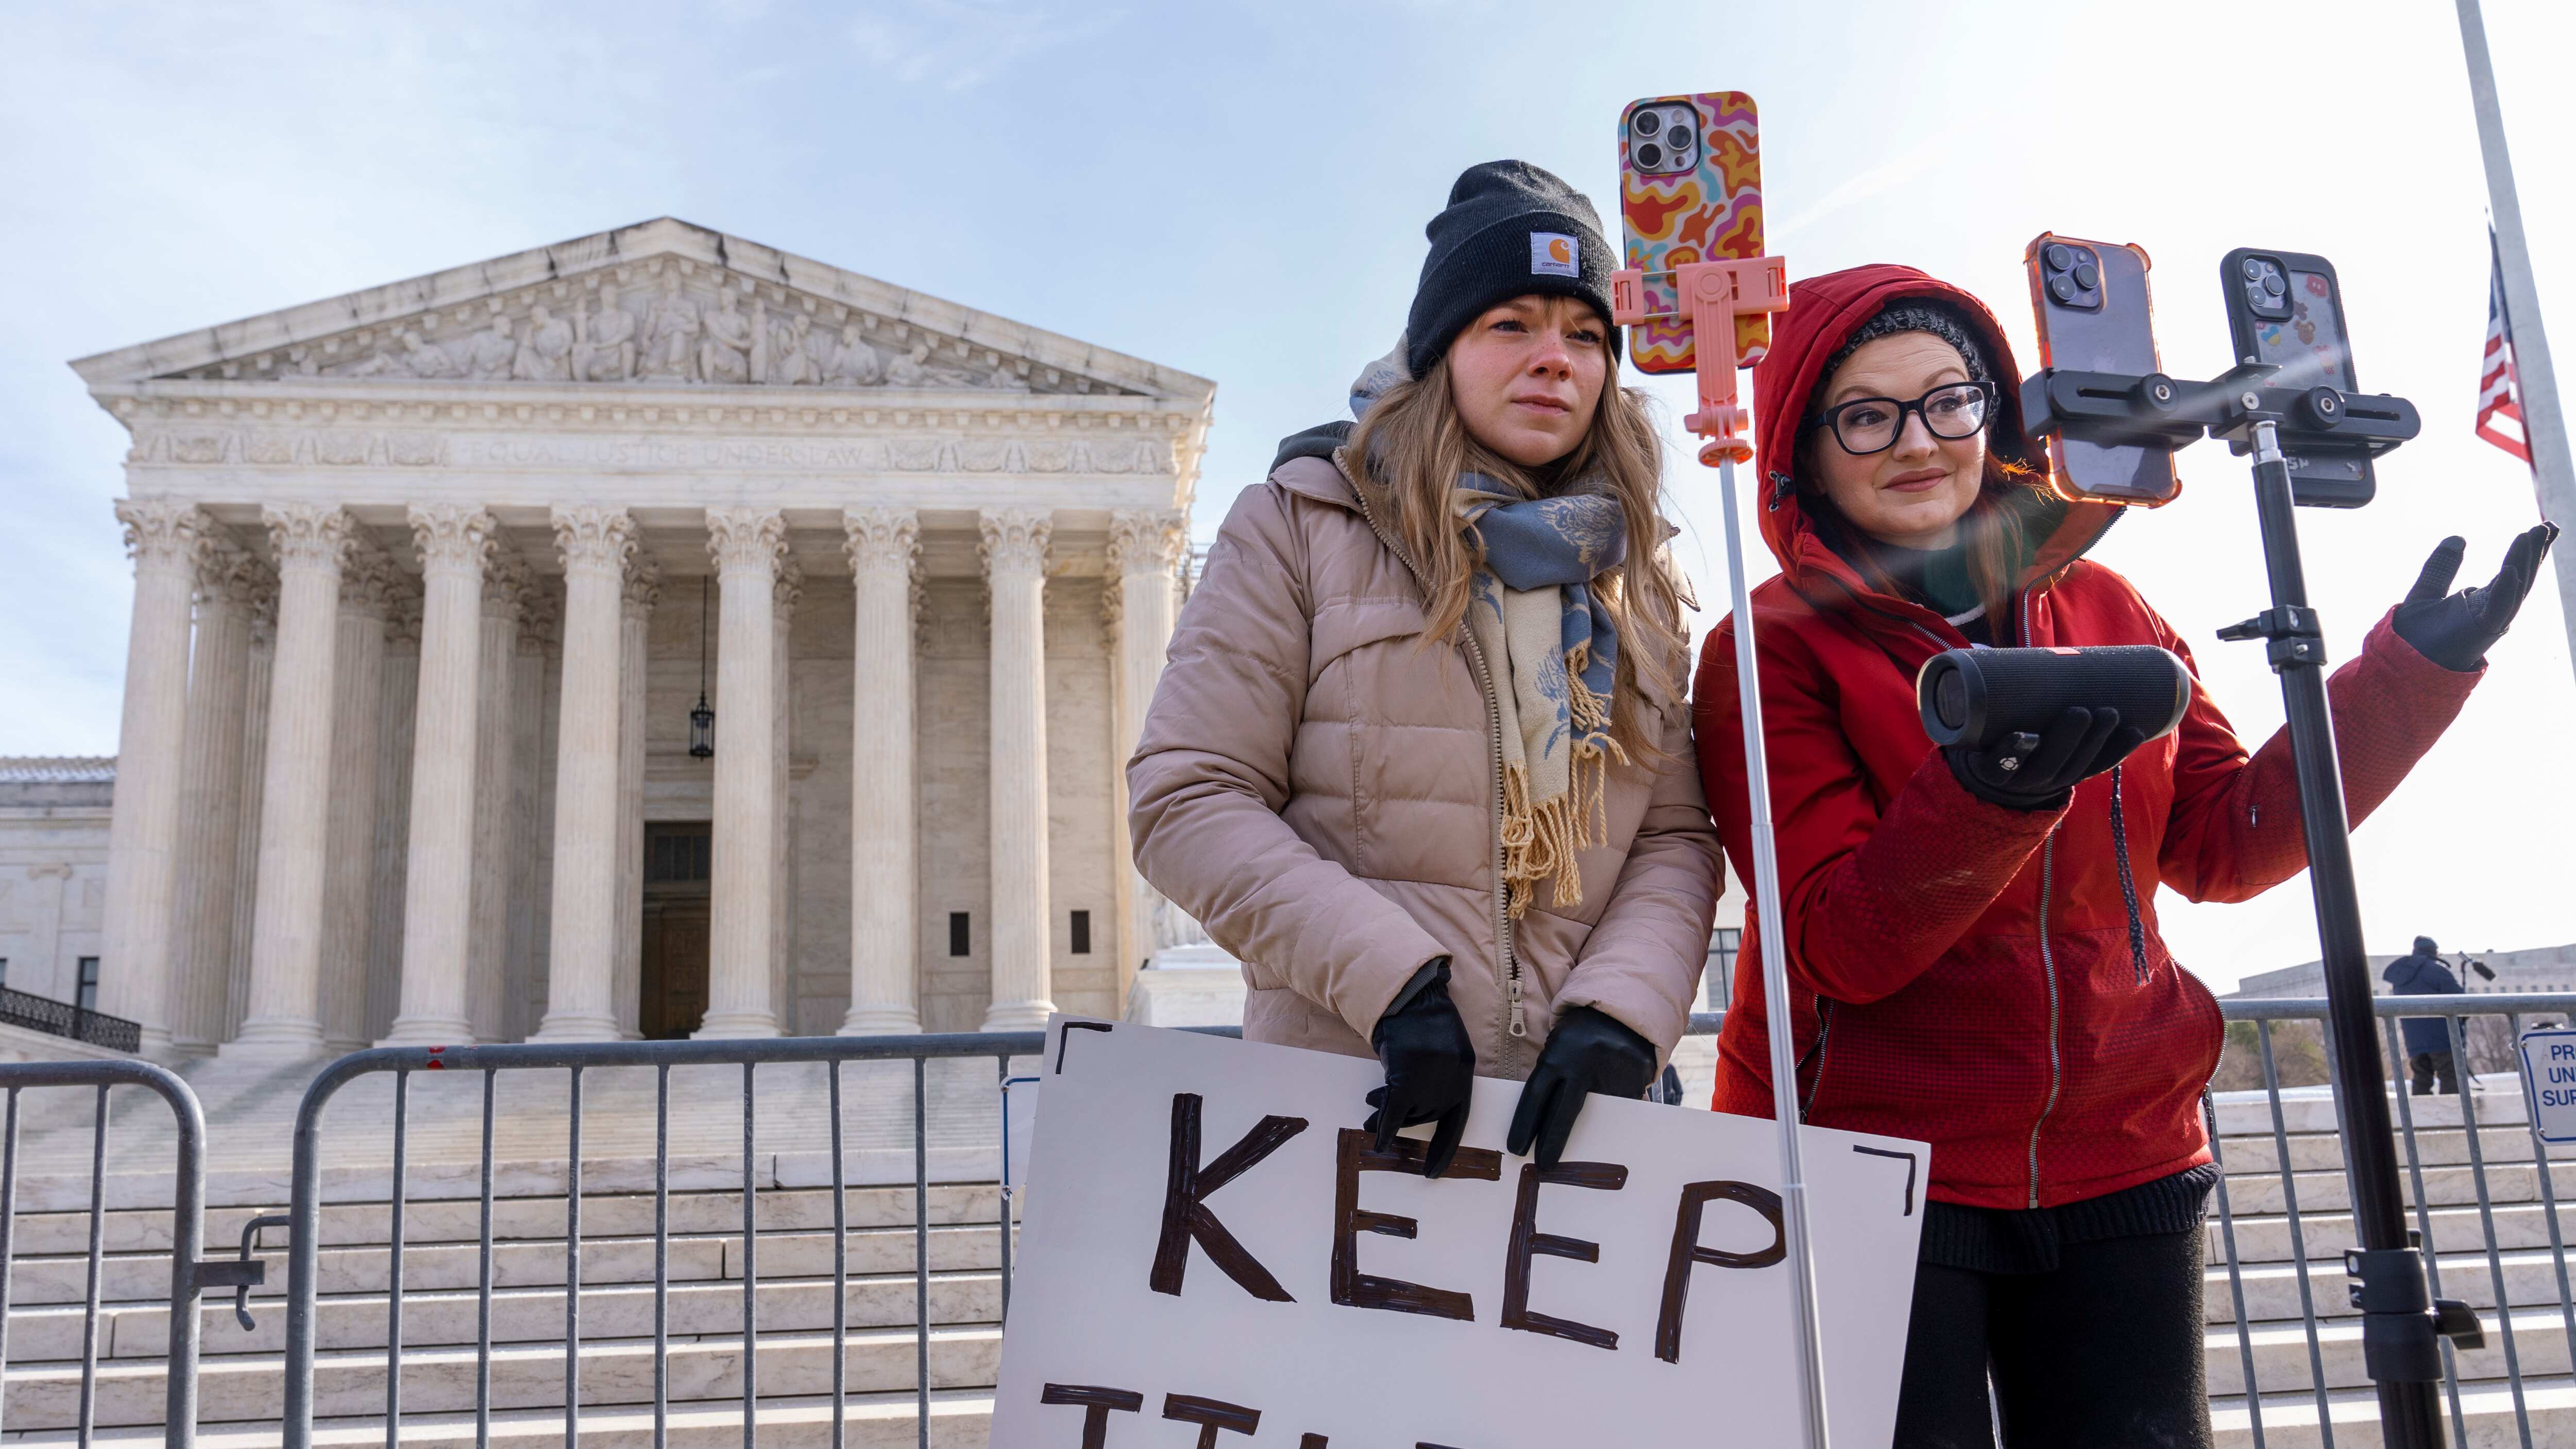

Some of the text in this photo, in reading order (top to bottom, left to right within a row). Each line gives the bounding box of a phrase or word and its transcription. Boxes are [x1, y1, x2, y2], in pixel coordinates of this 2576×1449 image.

[469, 441, 864, 465] EQUAL JUSTICE UNDER LAW
[2550, 1044, 2576, 1060] PR
[2548, 1067, 2576, 1083] UN
[1150, 1093, 1787, 1364] KEEP
